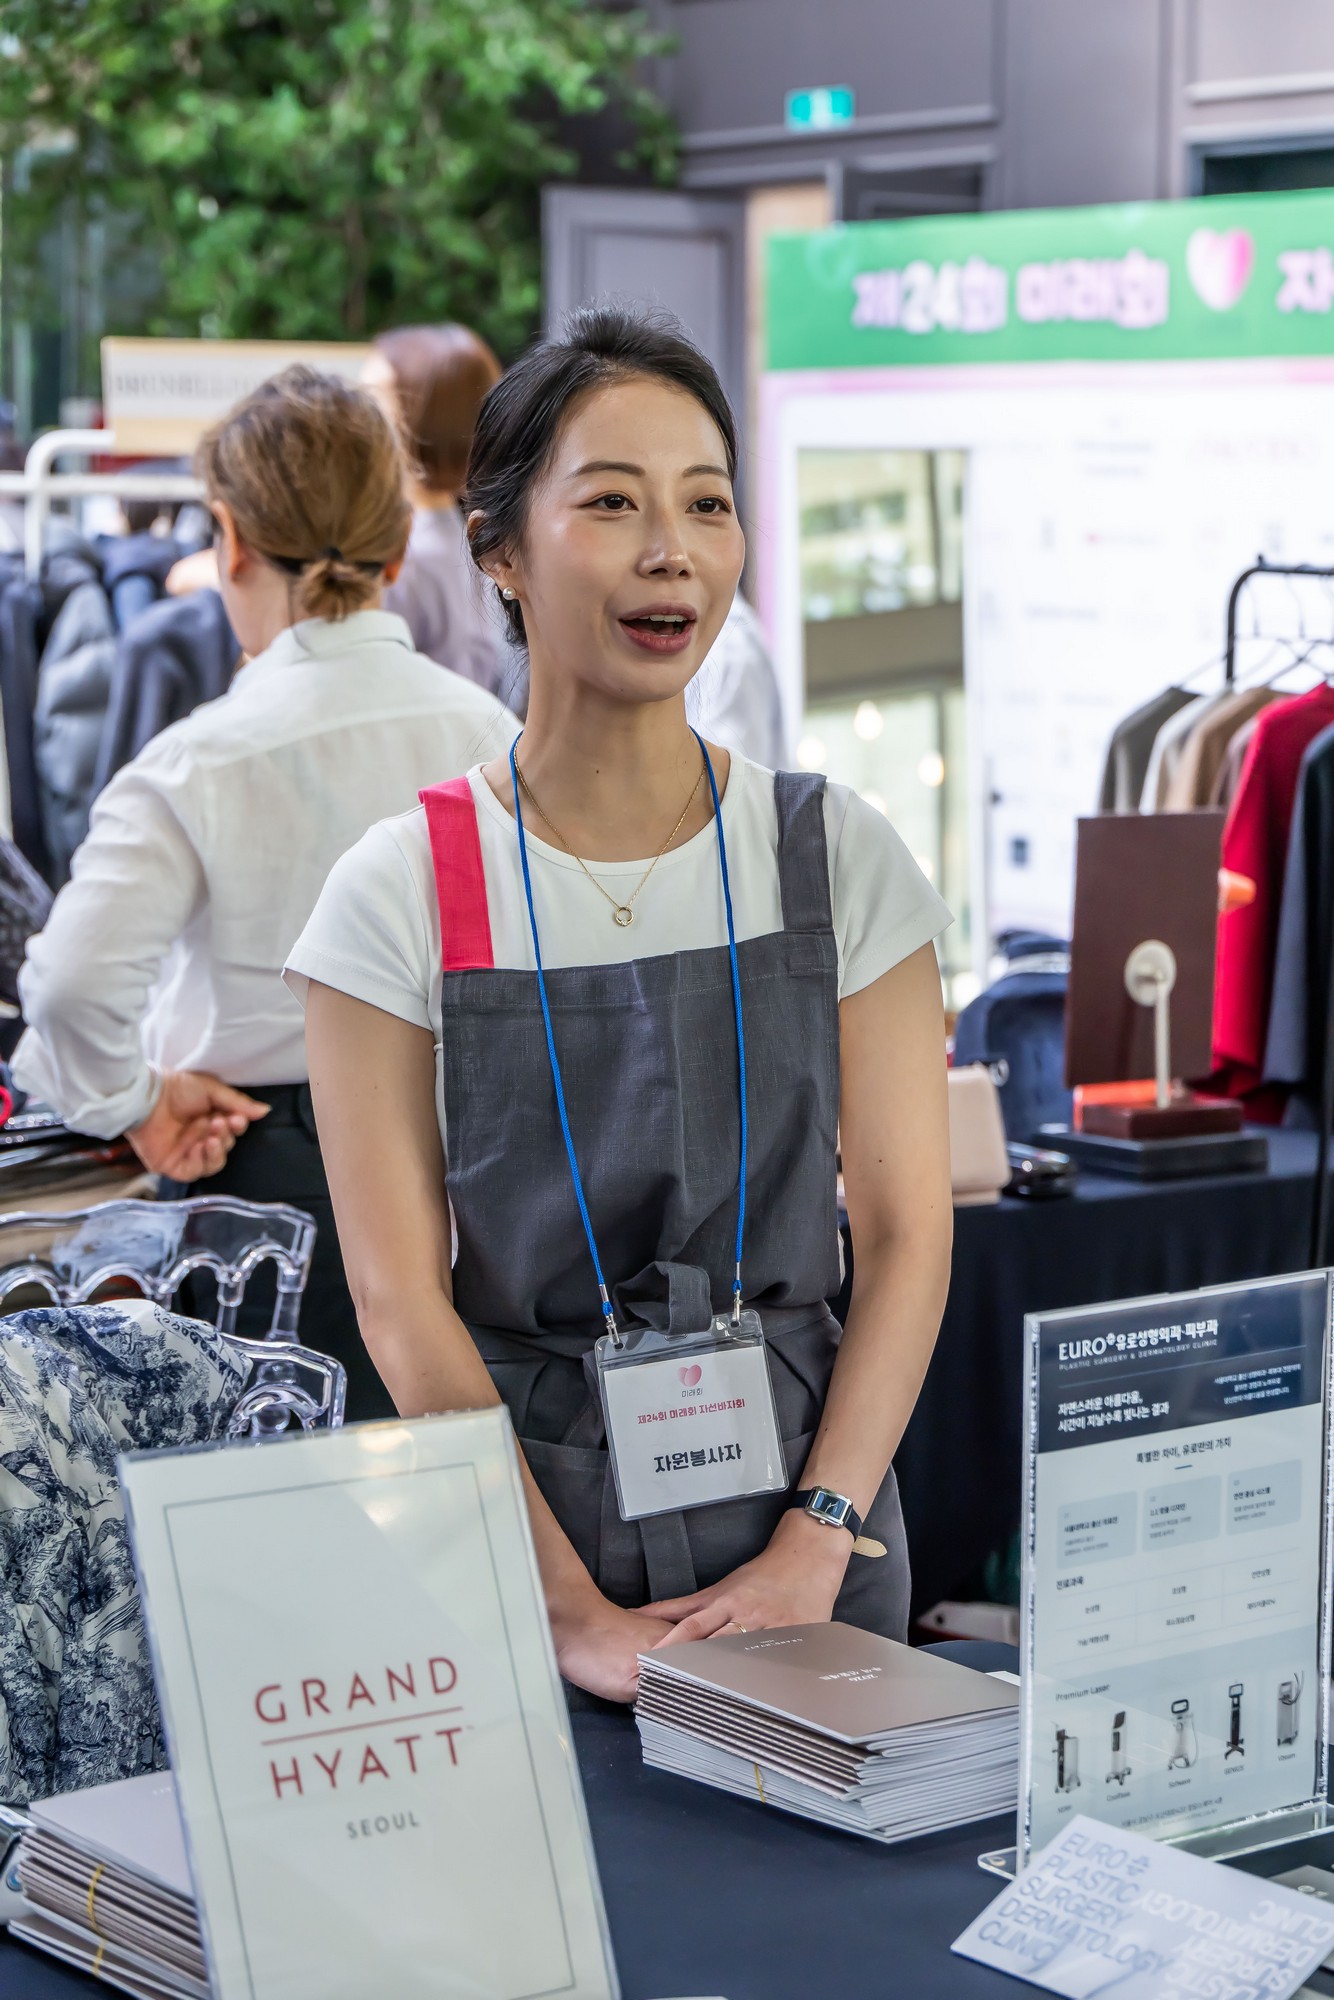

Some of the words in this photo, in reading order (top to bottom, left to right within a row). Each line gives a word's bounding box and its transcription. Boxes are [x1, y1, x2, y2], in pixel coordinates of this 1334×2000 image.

[852, 257, 1008, 333] 제24회
[1016, 248, 1169, 329] 미래회
[1059, 1337, 1106, 1361] EURO
[681, 1388, 703, 1398] 미래회
[1058, 1397, 1103, 1416] 자연스러운
[637, 1411, 667, 1424] 제24회
[669, 1406, 697, 1419] 미래회
[699, 1398, 745, 1414] 자선바자회
[1058, 1416, 1086, 1432] 시간이
[1087, 1409, 1122, 1427] 지날수록
[1123, 1405, 1150, 1422] 빛나는
[1151, 1401, 1170, 1417] 결과
[654, 1443, 742, 1473] 자원봉사자
[1136, 1449, 1160, 1463] 특별한
[1182, 1439, 1214, 1455] 유로만의
[1215, 1436, 1231, 1449] 가치
[255, 1657, 458, 1724] GRAND
[1055, 1686, 1089, 1702] Premium
[270, 1726, 463, 1800] HYATT
[346, 1810, 420, 1840] SEOUL
[1060, 1833, 1129, 1870] EURO
[1040, 1854, 1141, 1902] PLASTIC
[1019, 1876, 1137, 1931] SURGERY
[998, 1897, 1177, 1979] DERMATOLOGY
[1249, 1899, 1334, 1944] CLINIC
[977, 1921, 1057, 1963] CLINIC
